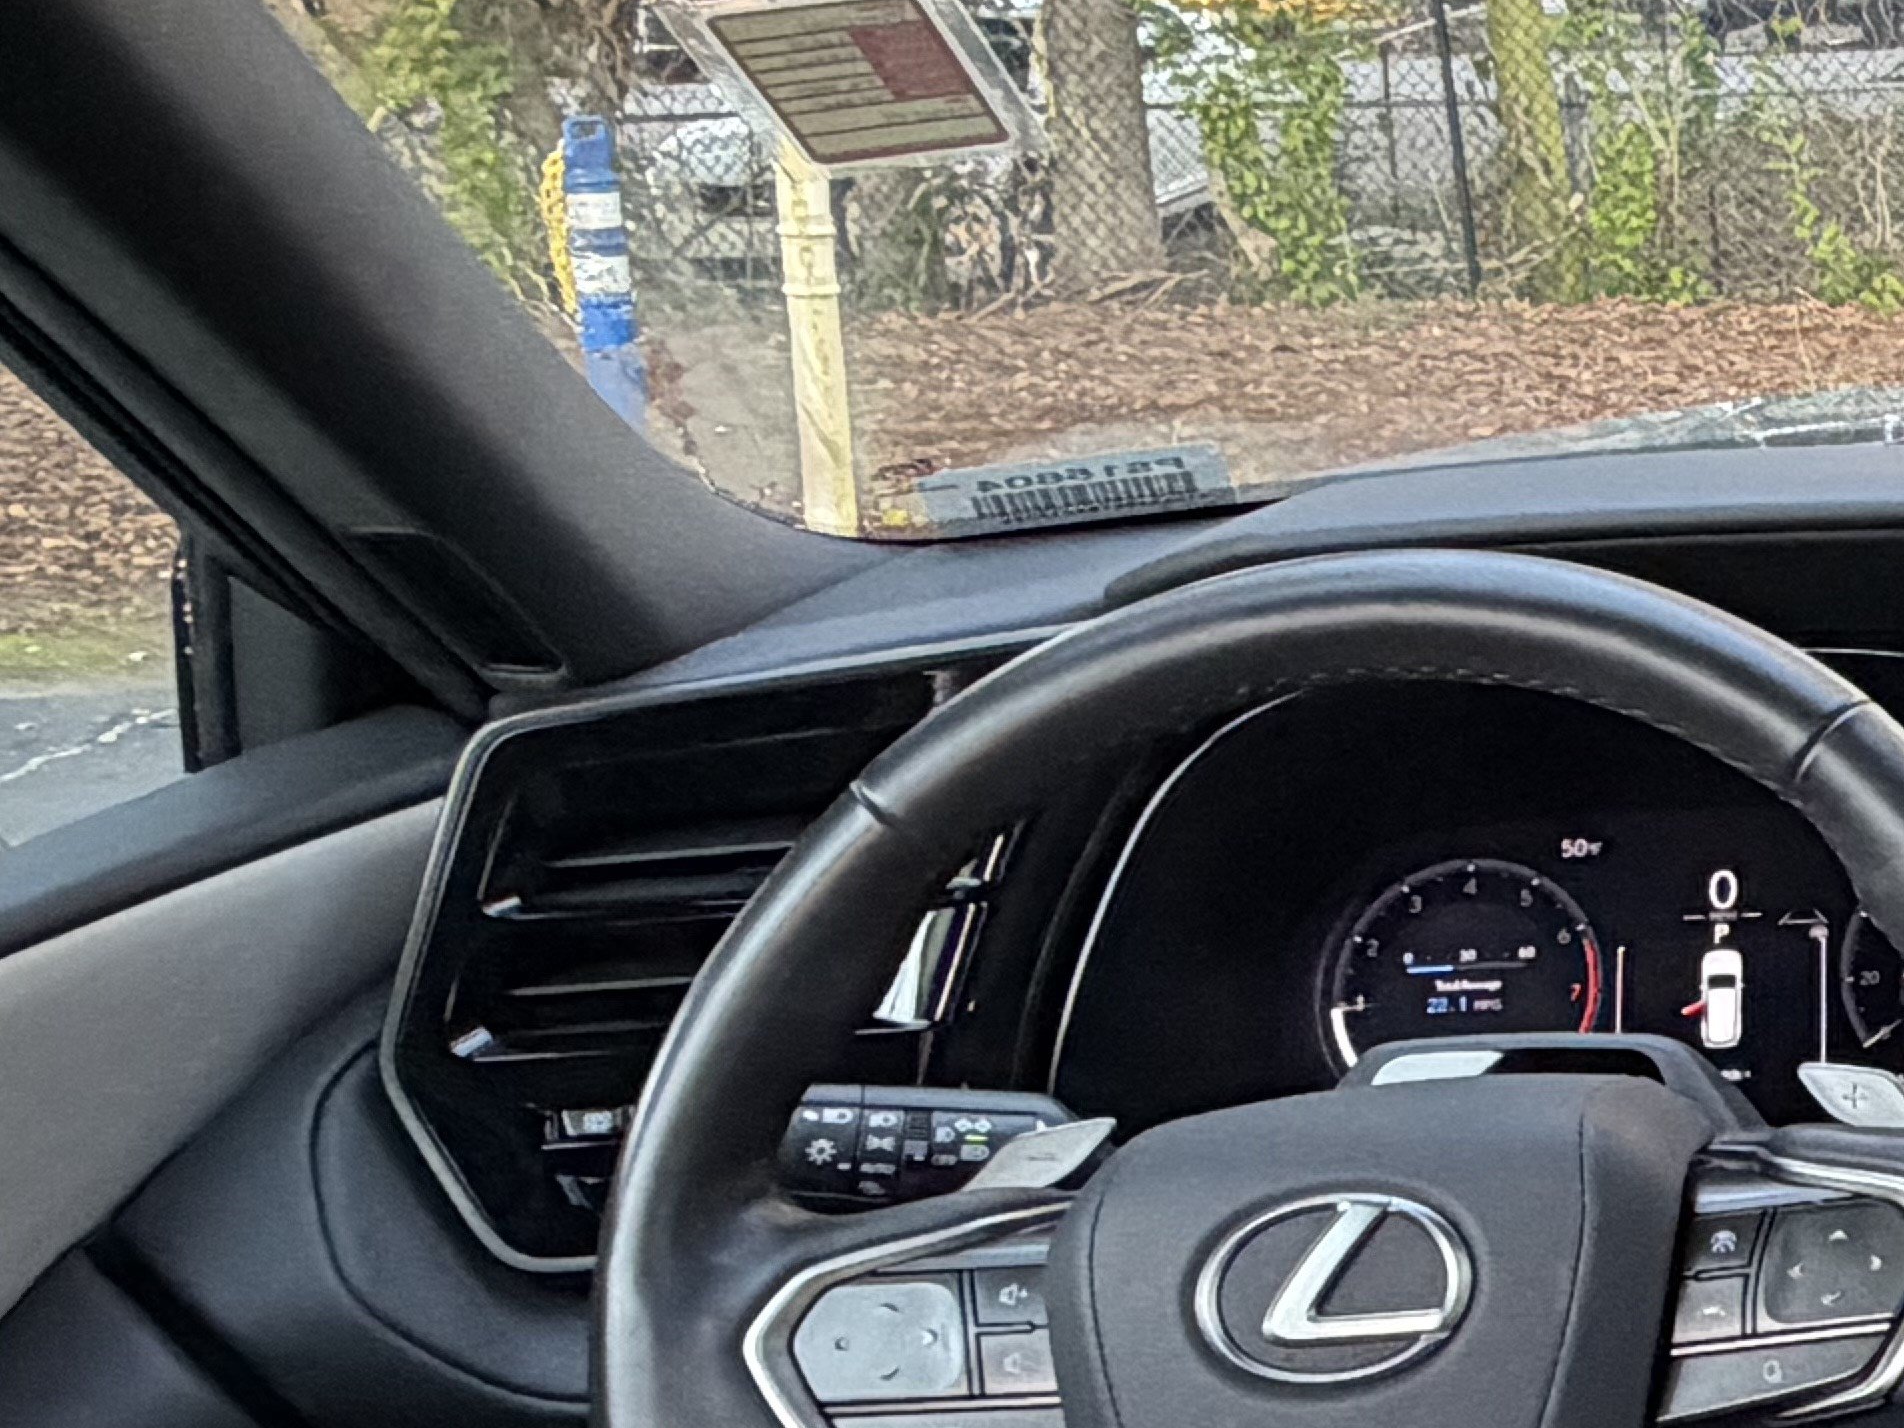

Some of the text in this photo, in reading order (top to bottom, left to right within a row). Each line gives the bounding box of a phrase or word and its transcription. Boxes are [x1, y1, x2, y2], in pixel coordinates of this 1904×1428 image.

[1462, 878, 1478, 895] 4
[1707, 868, 1739, 910] 0
[1409, 894, 1424, 913] 3
[1519, 888, 1534, 907] 5
[1556, 927, 1571, 945] 6
[1713, 924, 1731, 944] P
[1365, 938, 1380, 958] 2
